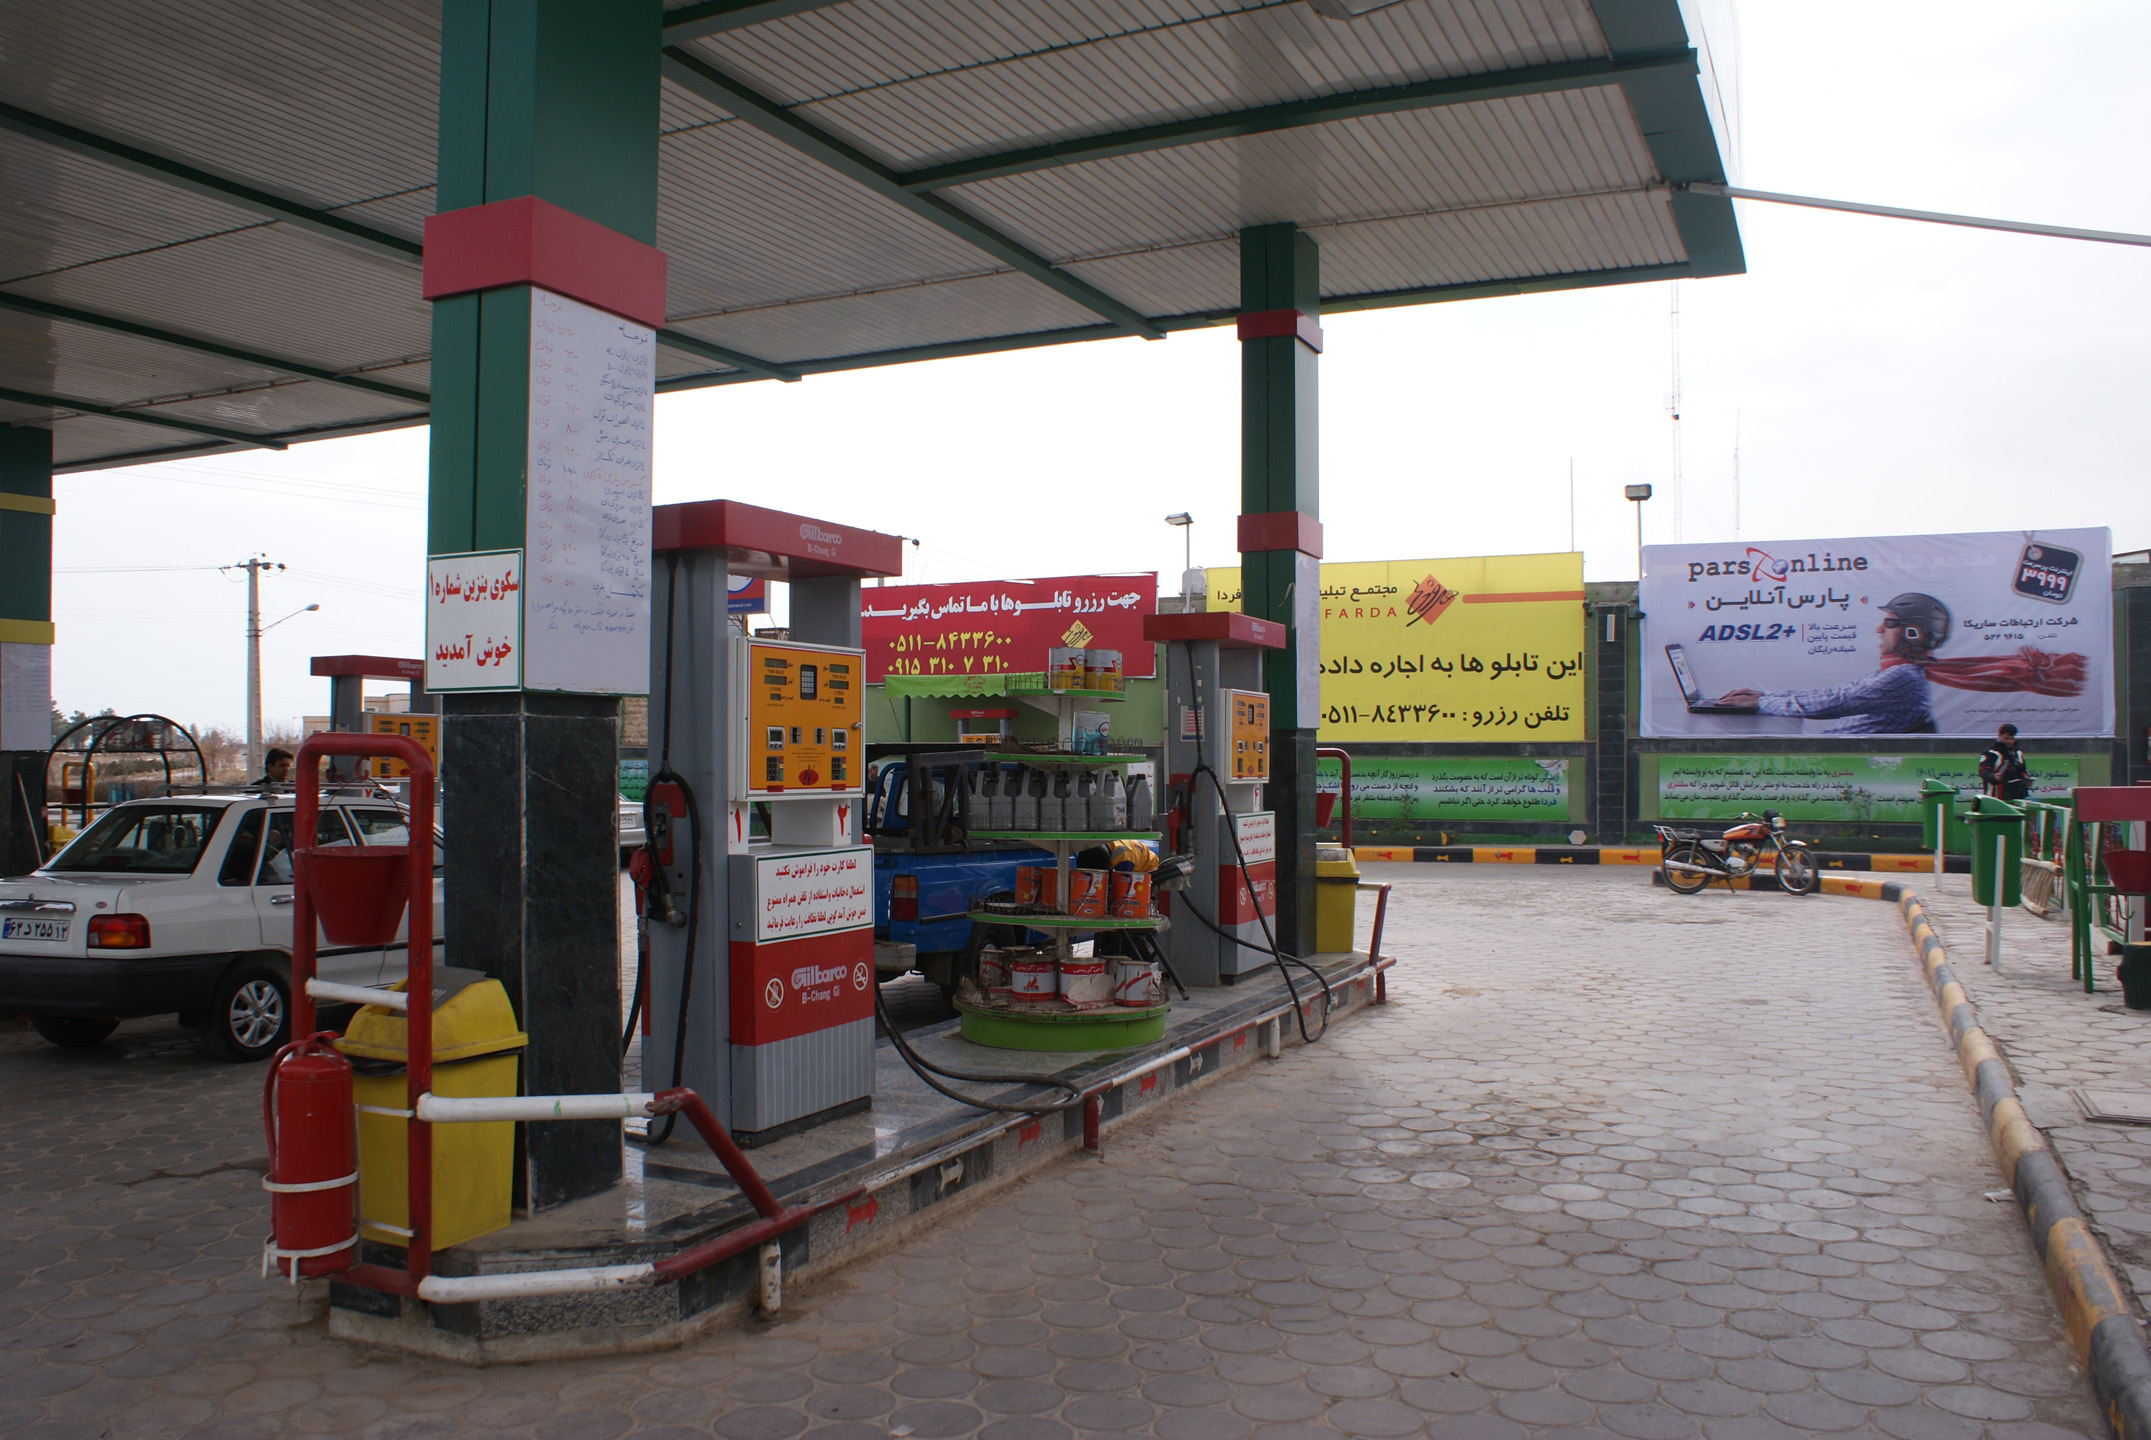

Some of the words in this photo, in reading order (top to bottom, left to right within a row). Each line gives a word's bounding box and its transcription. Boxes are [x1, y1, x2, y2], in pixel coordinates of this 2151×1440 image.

[799, 523, 842, 545] Gilbarco
[490, 569, 518, 601] سکوی
[2021, 567, 2068, 592] ۳۹۹۹
[435, 573, 461, 604] شماره
[464, 575, 488, 602] بنزین
[1350, 585, 1398, 602] مجتمع
[2042, 590, 2063, 599] تومان
[966, 595, 988, 612] ما
[990, 593, 999, 616] با
[1001, 590, 1072, 616] تابلوها
[1073, 592, 1105, 613] رزرو
[1107, 591, 1141, 610] جهت
[1705, 586, 1785, 612] آنلاین
[1787, 588, 1849, 612] پارس
[931, 596, 965, 619] تماس
[1324, 607, 1397, 619] FARDA
[1807, 623, 1820, 631] بالا
[1823, 623, 1857, 631] سرعت
[1963, 619, 1997, 630] ساریکا
[1999, 617, 2043, 628] ارتباطات
[2046, 616, 2078, 627] شرکت
[1697, 623, 1796, 643] ADSL2+
[1807, 632, 1828, 643] پایین
[1830, 631, 1857, 640] قیمت
[436, 634, 474, 667] آمدید
[477, 636, 512, 667] خوش
[888, 657, 921, 675] ۰۹۱۵
[928, 656, 954, 674] ۳۱۰
[963, 655, 974, 673] ۷
[982, 655, 1009, 672] ۳۱۰
[1370, 654, 1424, 679] اجاره
[1431, 656, 1454, 678] به
[1461, 653, 1484, 673] ها
[1490, 652, 1539, 680] تابلو
[1546, 651, 1583, 680] این
[1524, 704, 1570, 729] تلفن
[1431, 772, 1448, 781] بگذرد
[1449, 773, 1472, 783] خصومت
[1524, 773, 1538, 783] کوتاه
[1540, 773, 1559, 782] زندگی
[1724, 768, 1743, 778] هستیم
[1796, 769, 1815, 778] وابسته
[1831, 769, 1854, 778] مشتری
[1935, 770, 1963, 780] سرخس
[2043, 770, 2069, 780] منشور
[1360, 784, 1370, 792] می
[1433, 785, 1459, 794] بشکنند
[1504, 784, 1527, 795] گرامی
[1527, 785, 1536, 793] ها
[1667, 781, 1688, 789] مشتری
[2040, 784, 2067, 793] مشتری
[1438, 798, 1459, 808] نباشیم
[1460, 797, 1471, 806] اگر
[1486, 798, 1500, 806] کرد
[1501, 798, 1521, 807] خواهد
[1522, 799, 1542, 808] طلوع
[1541, 798, 1557, 807] فردا
[1810, 796, 1820, 804] می
[791, 861, 812, 879] فراموش
[813, 862, 819, 876] را
[820, 861, 830, 876] خود
[832, 860, 845, 874] کارت
[846, 859, 857, 870] لطفا
[776, 864, 790, 880] نکنید
[797, 890, 807, 906] تلفن
[808, 889, 813, 905] از
[832, 886, 848, 902] دخانیات
[849, 884, 865, 899] استعمال
[767, 896, 782, 911] ممنوع
[783, 892, 796, 907] همراه
[804, 911, 817, 924] نظافت
[817, 910, 826, 922] لطفا
[846, 907, 857, 921] خوش
[785, 914, 798, 930] رعایت
[791, 964, 848, 990] Gilbarco
